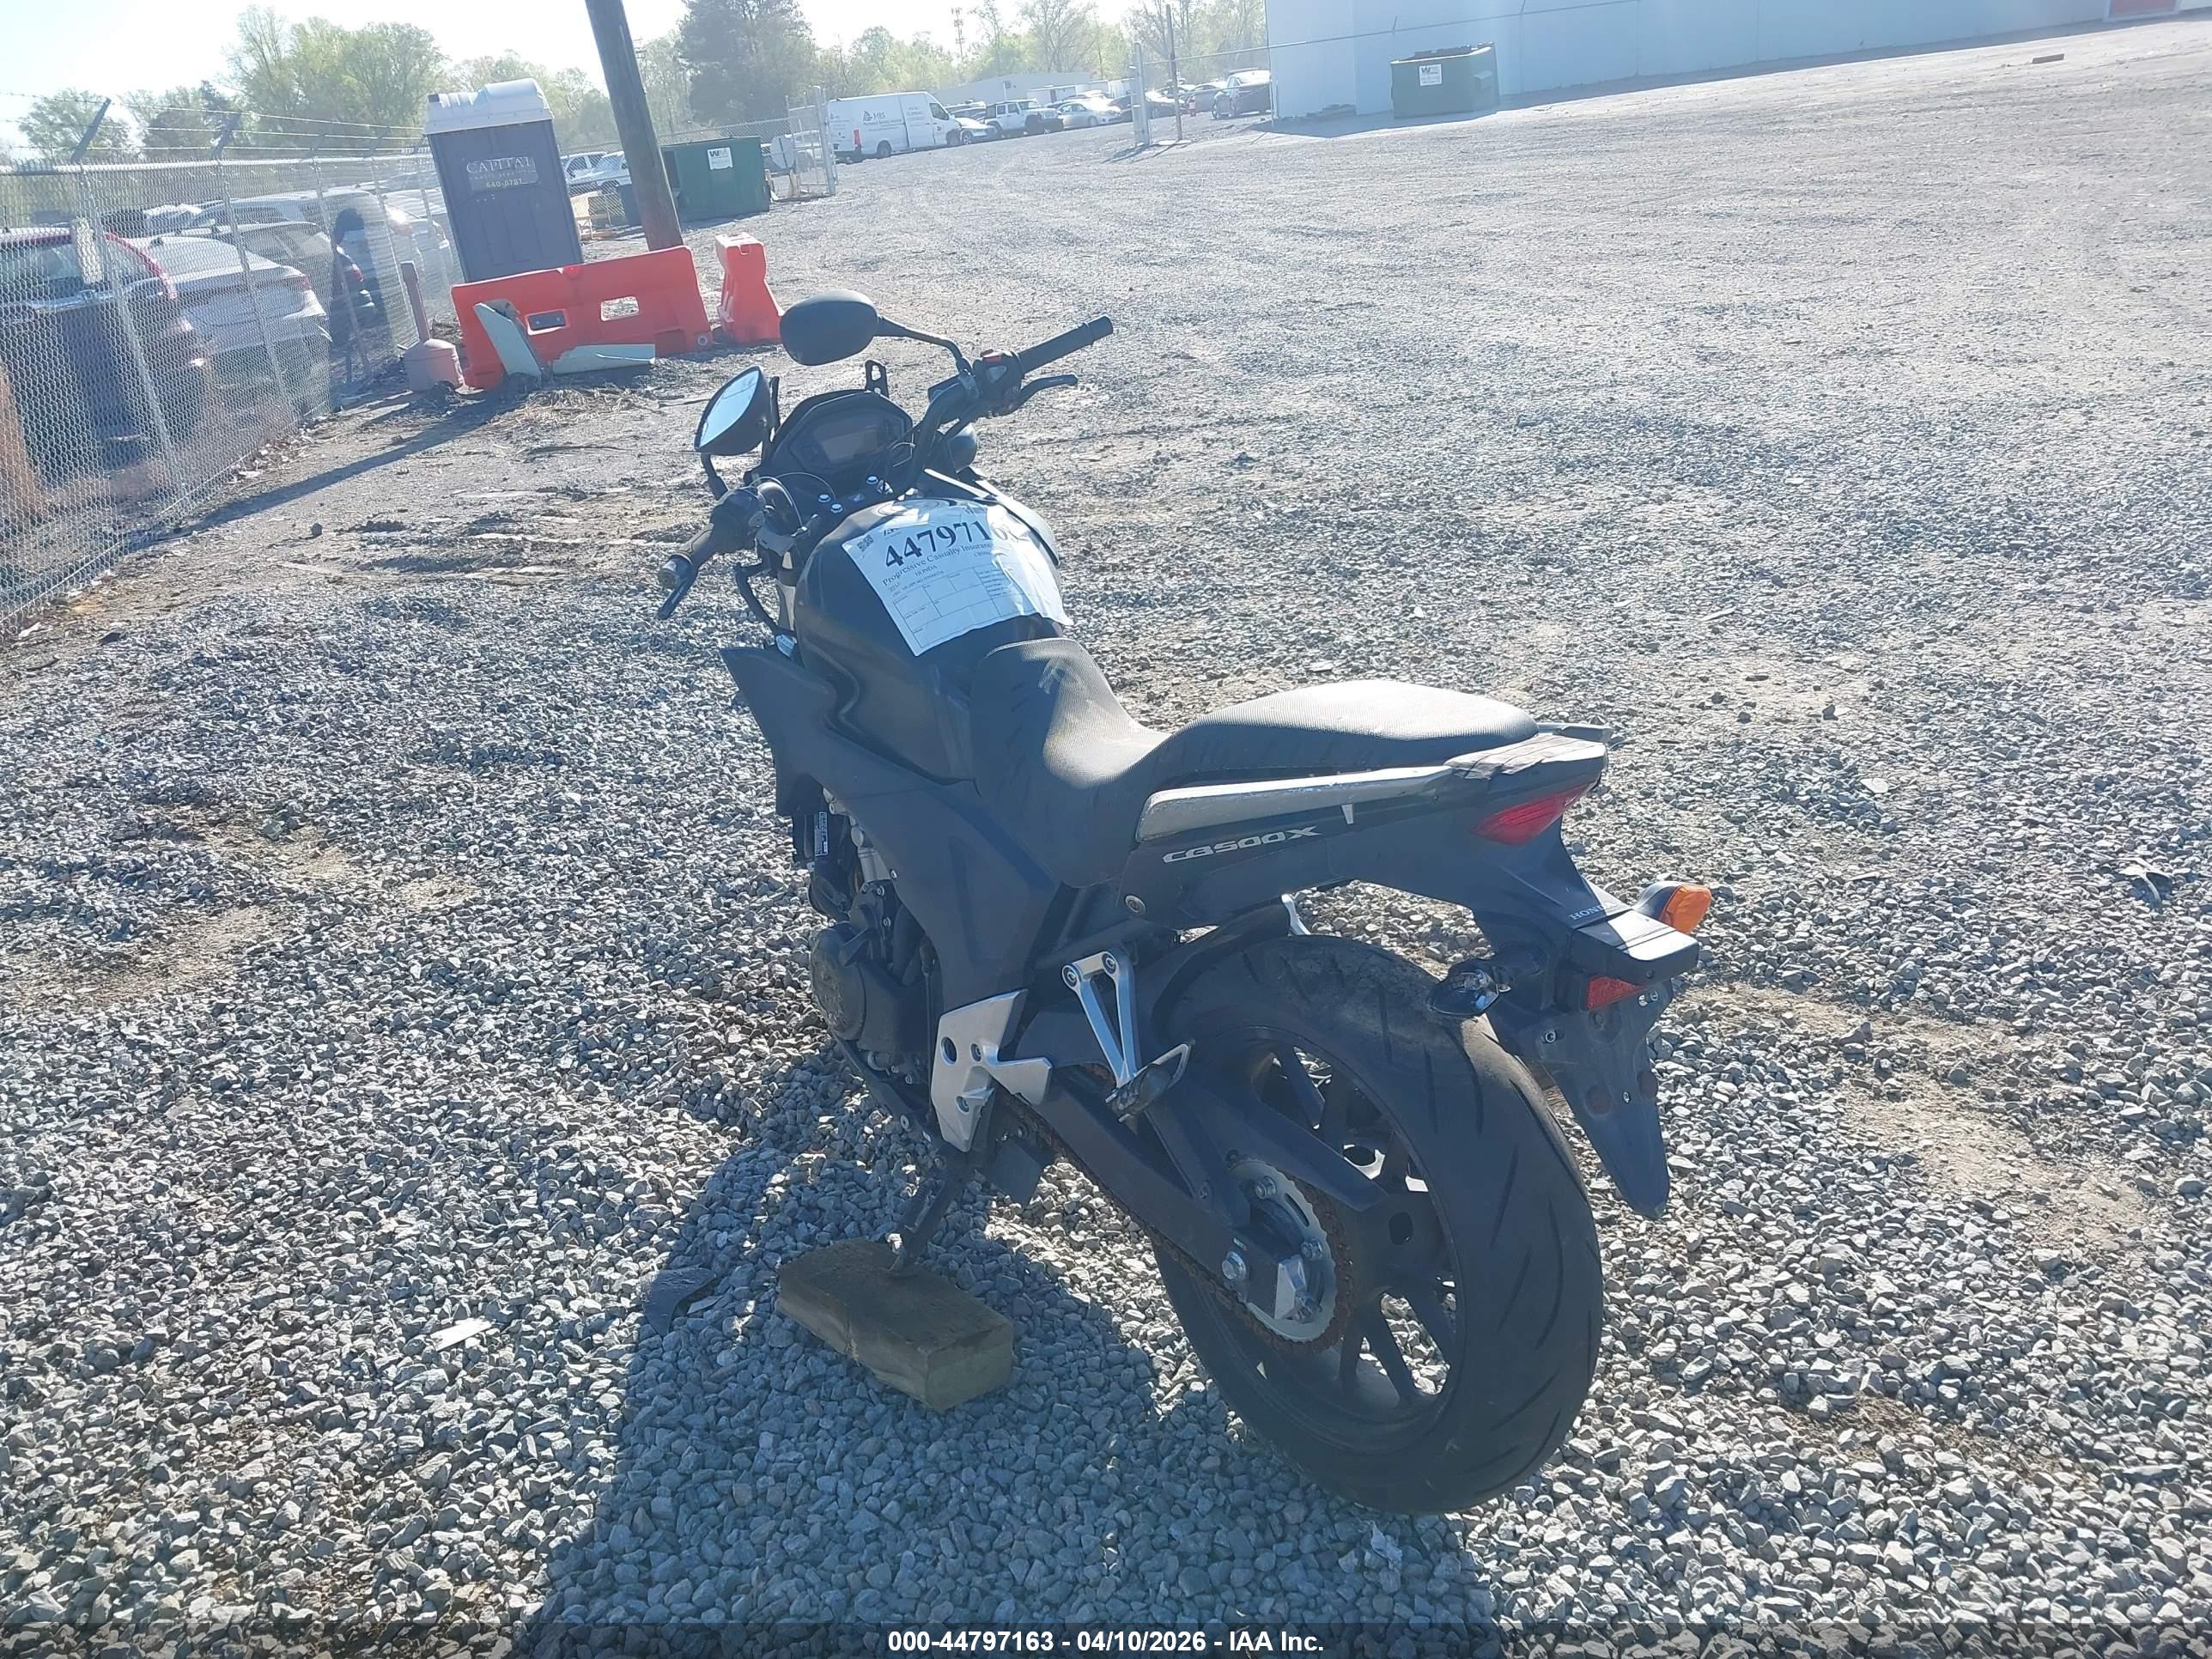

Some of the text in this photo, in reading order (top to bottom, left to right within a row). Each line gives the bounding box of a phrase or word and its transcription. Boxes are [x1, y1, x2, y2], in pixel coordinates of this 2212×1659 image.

[466, 156, 537, 173] CAPITAL
[882, 559, 926, 586] Progressive
[927, 547, 960, 562] Casualty
[915, 564, 938, 577] HONDA
[1162, 825, 1323, 864] CB500X
